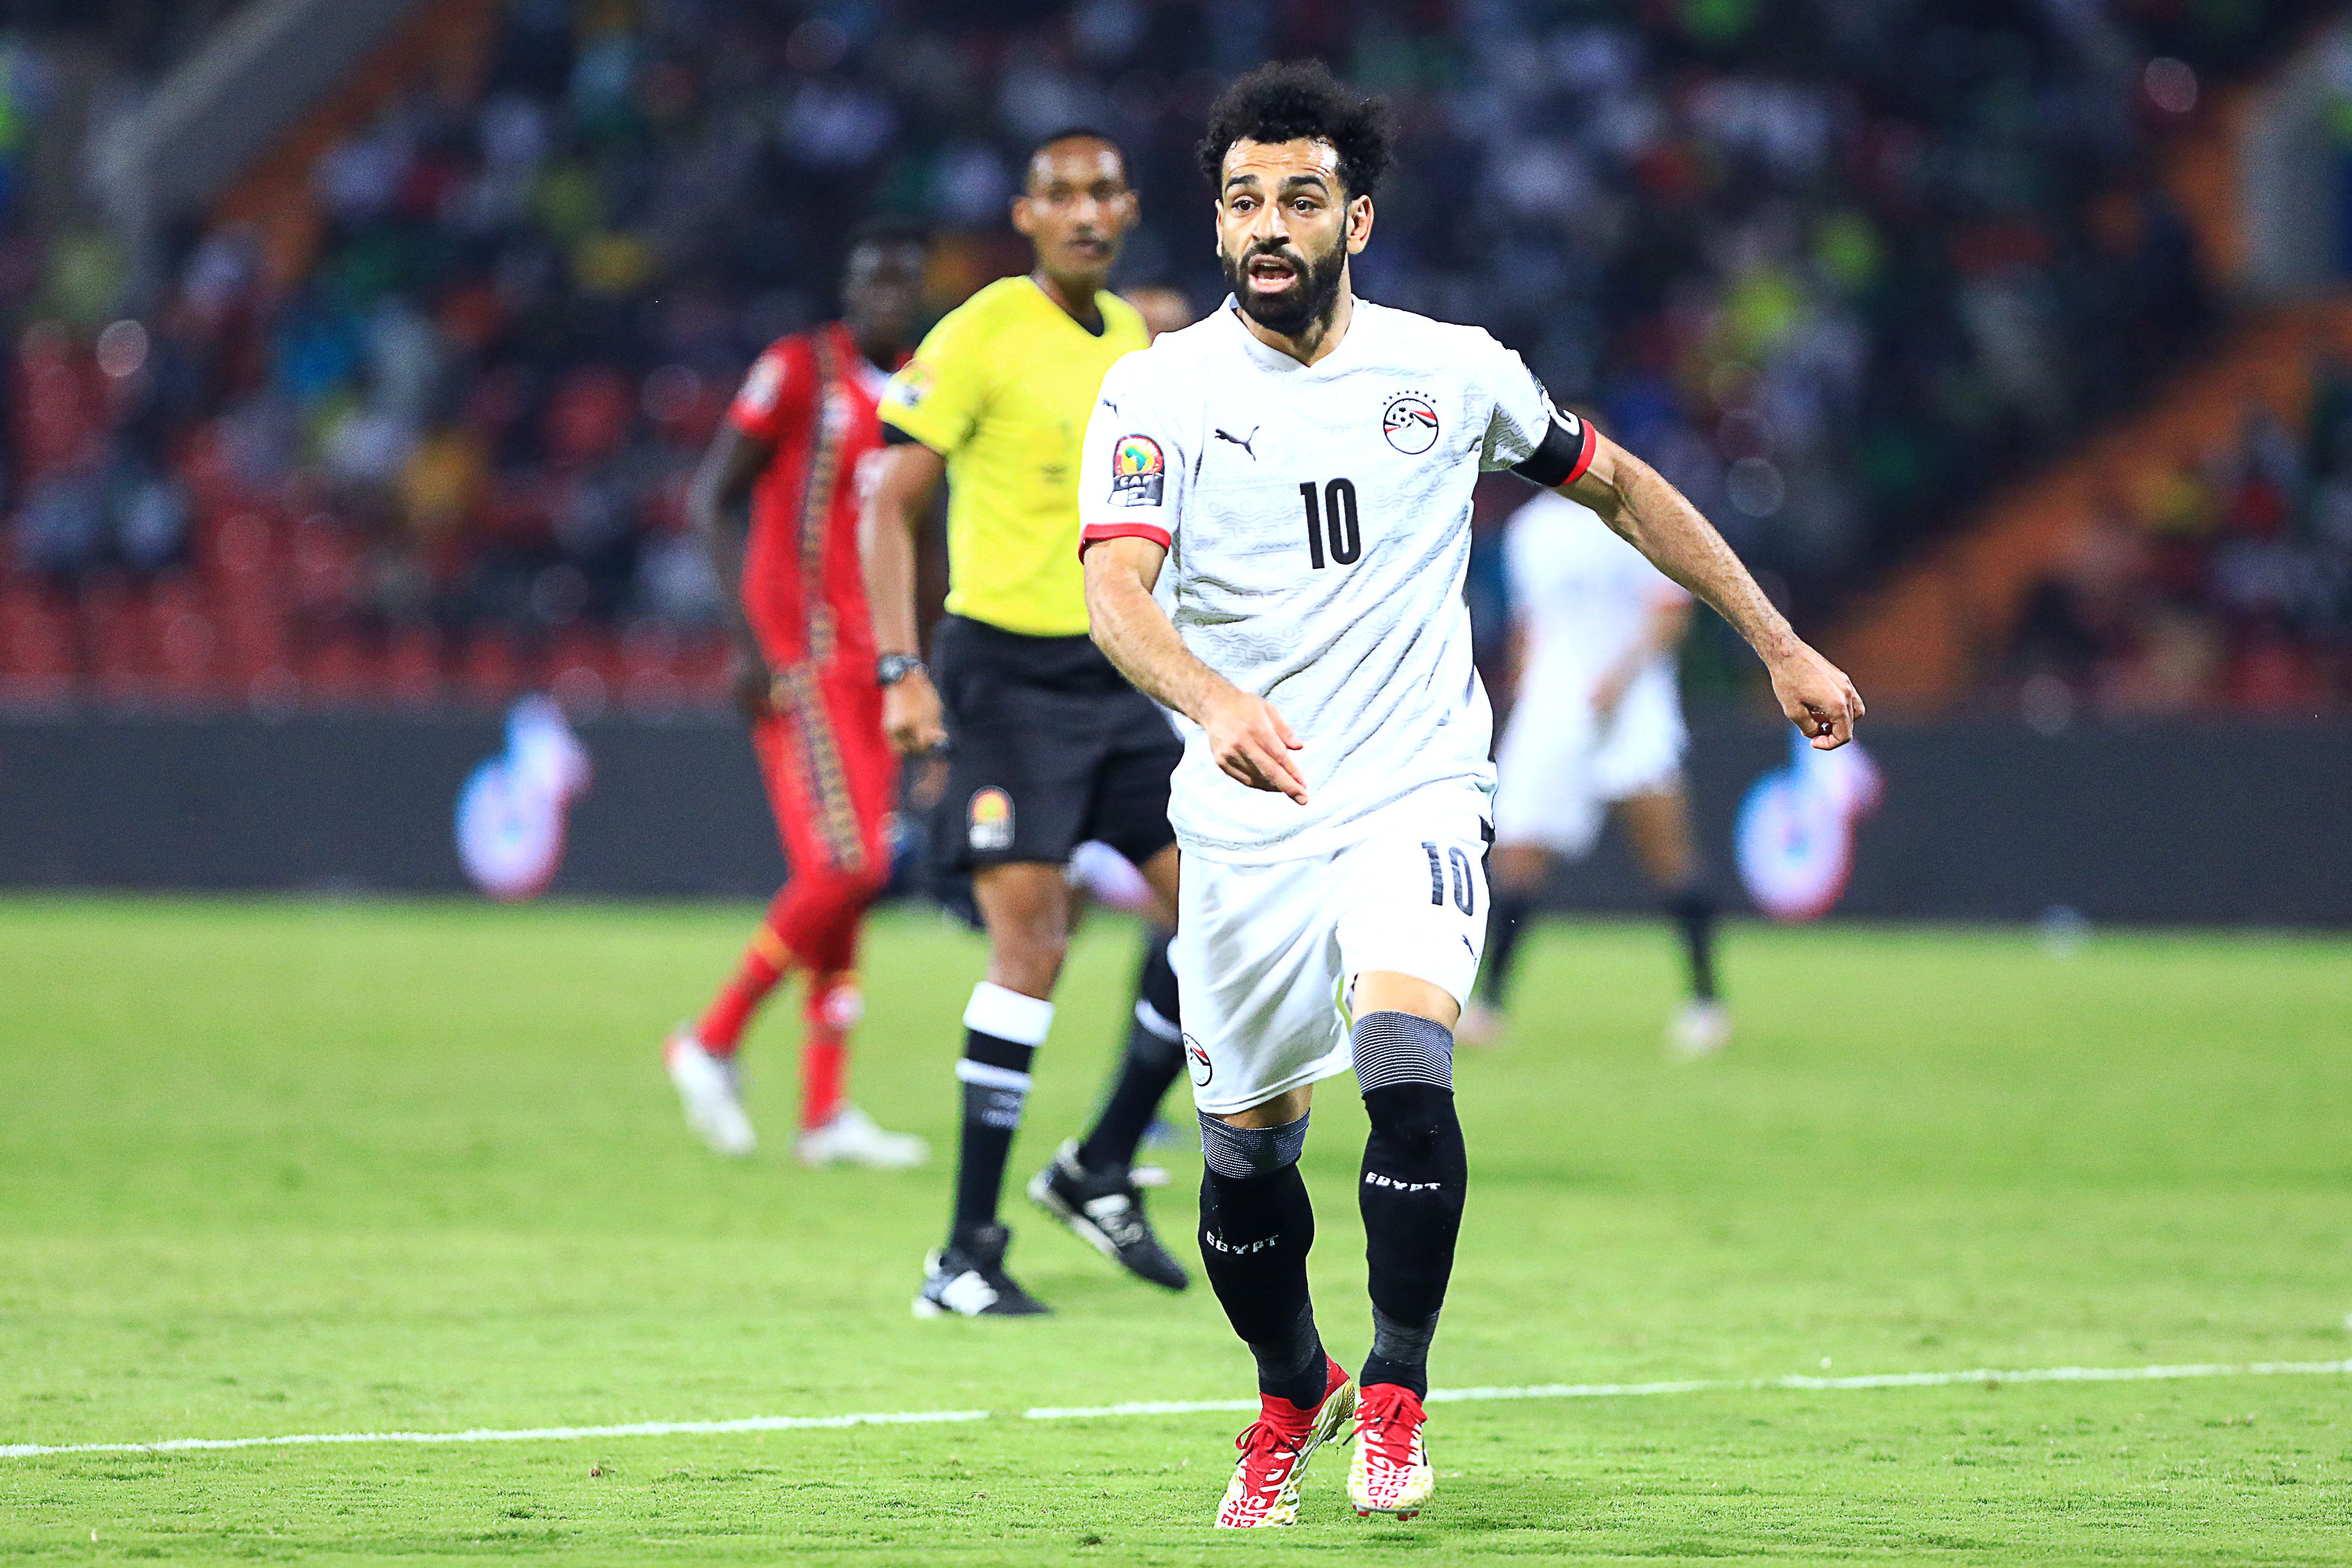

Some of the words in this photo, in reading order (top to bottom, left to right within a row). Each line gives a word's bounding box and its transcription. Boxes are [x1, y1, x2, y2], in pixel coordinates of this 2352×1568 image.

[1299, 479, 1361, 569] 10
[1421, 841, 1474, 916] 10
[1206, 1230, 1279, 1254] EGYPT
